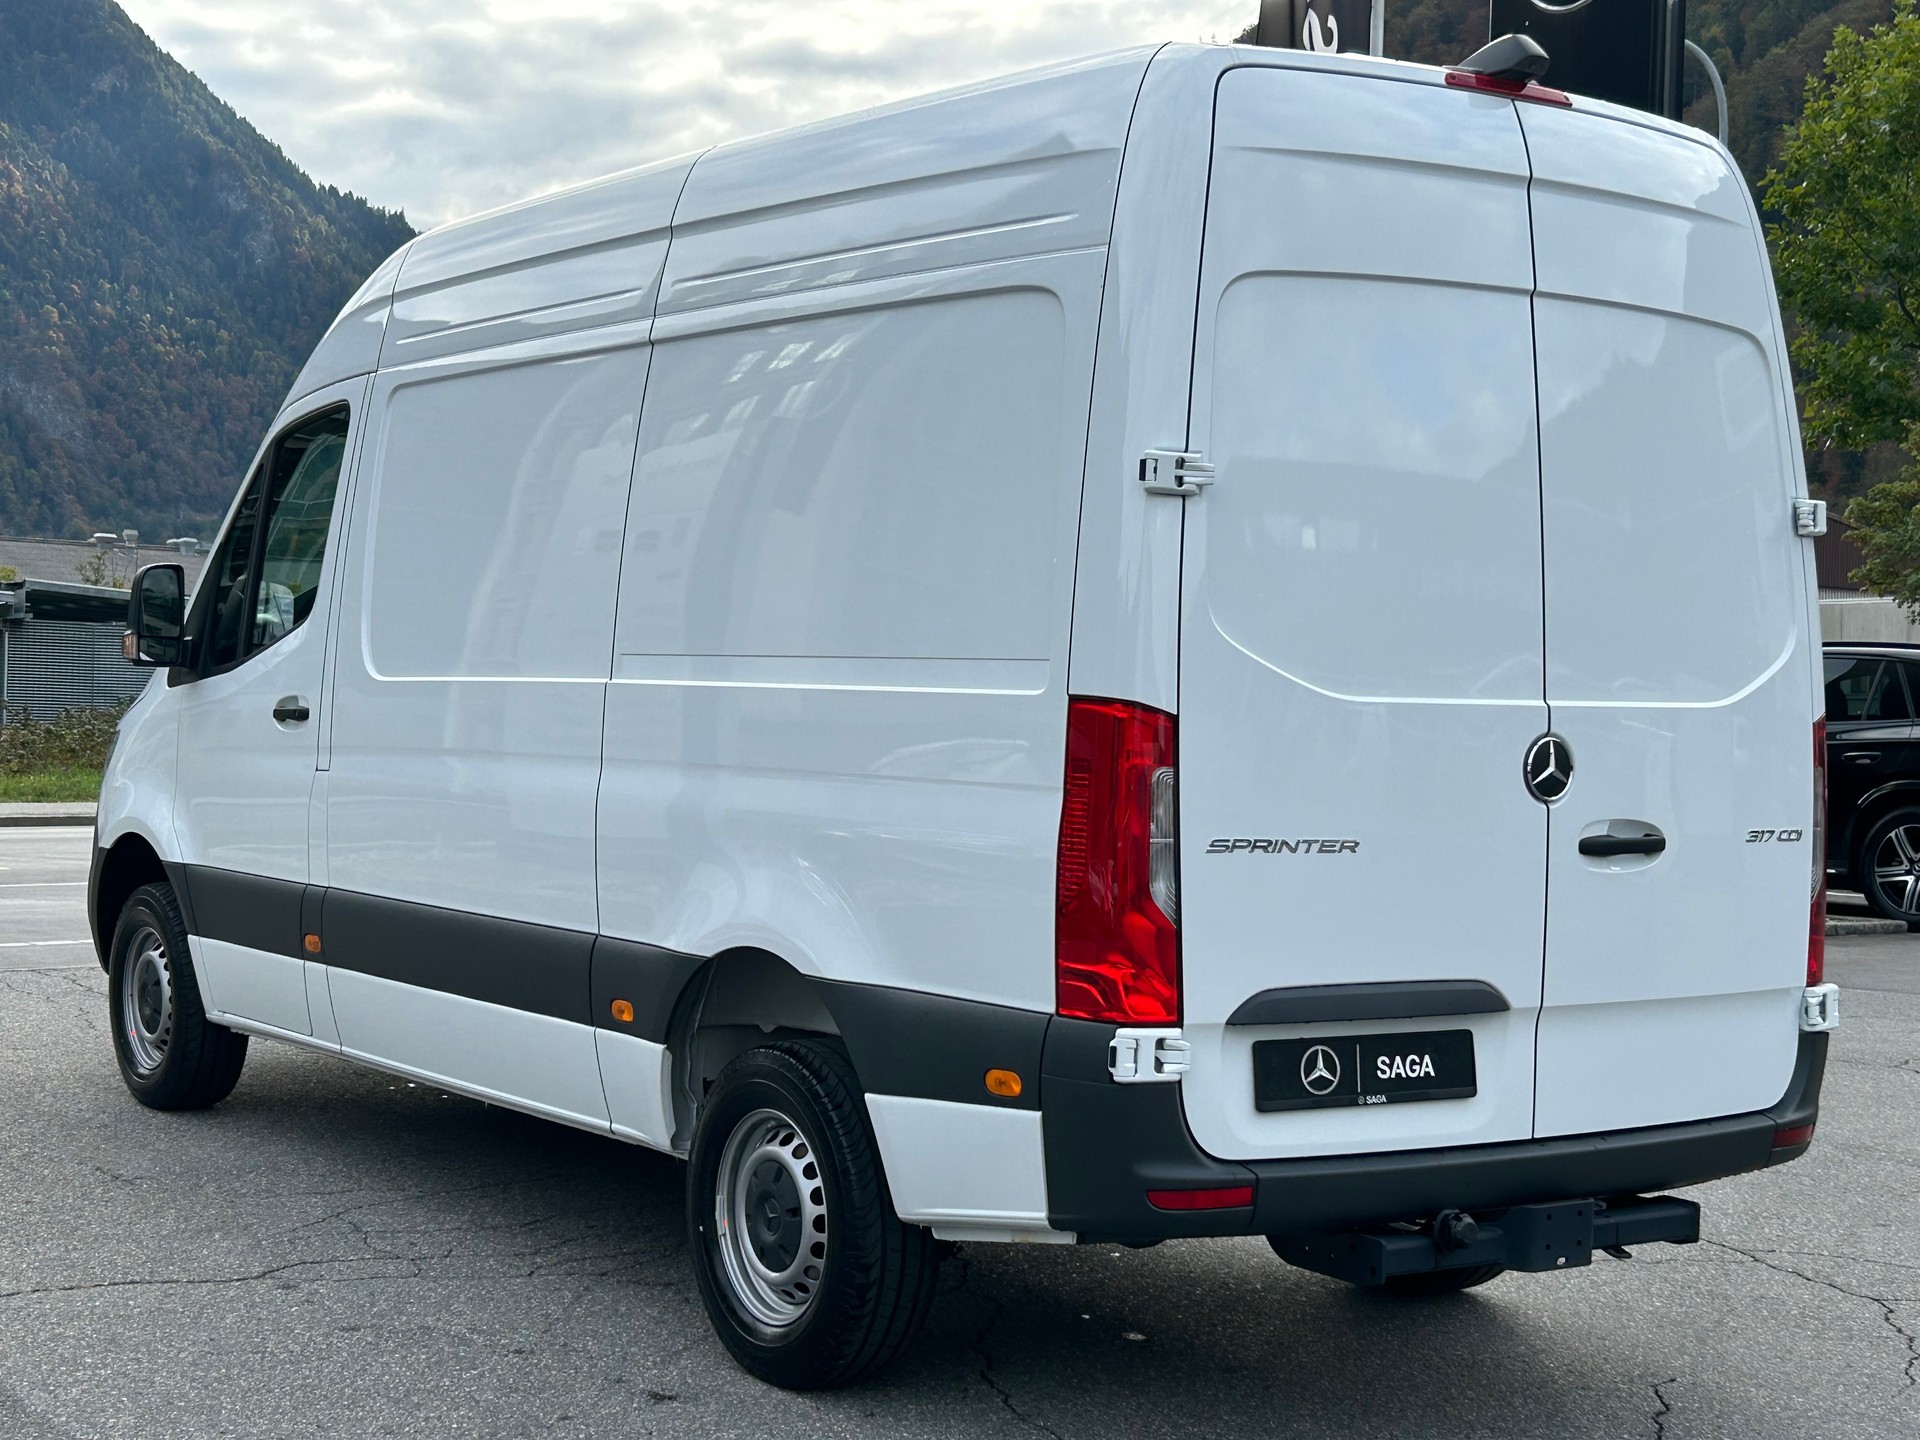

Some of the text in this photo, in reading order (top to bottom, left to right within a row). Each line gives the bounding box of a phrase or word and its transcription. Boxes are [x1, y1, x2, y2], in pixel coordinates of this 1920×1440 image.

[1745, 829, 1803, 843] 317 CDI
[1205, 838, 1360, 854] SPRINTER
[1376, 1054, 1436, 1079] SAGA
[1366, 1094, 1387, 1105] SAGA
